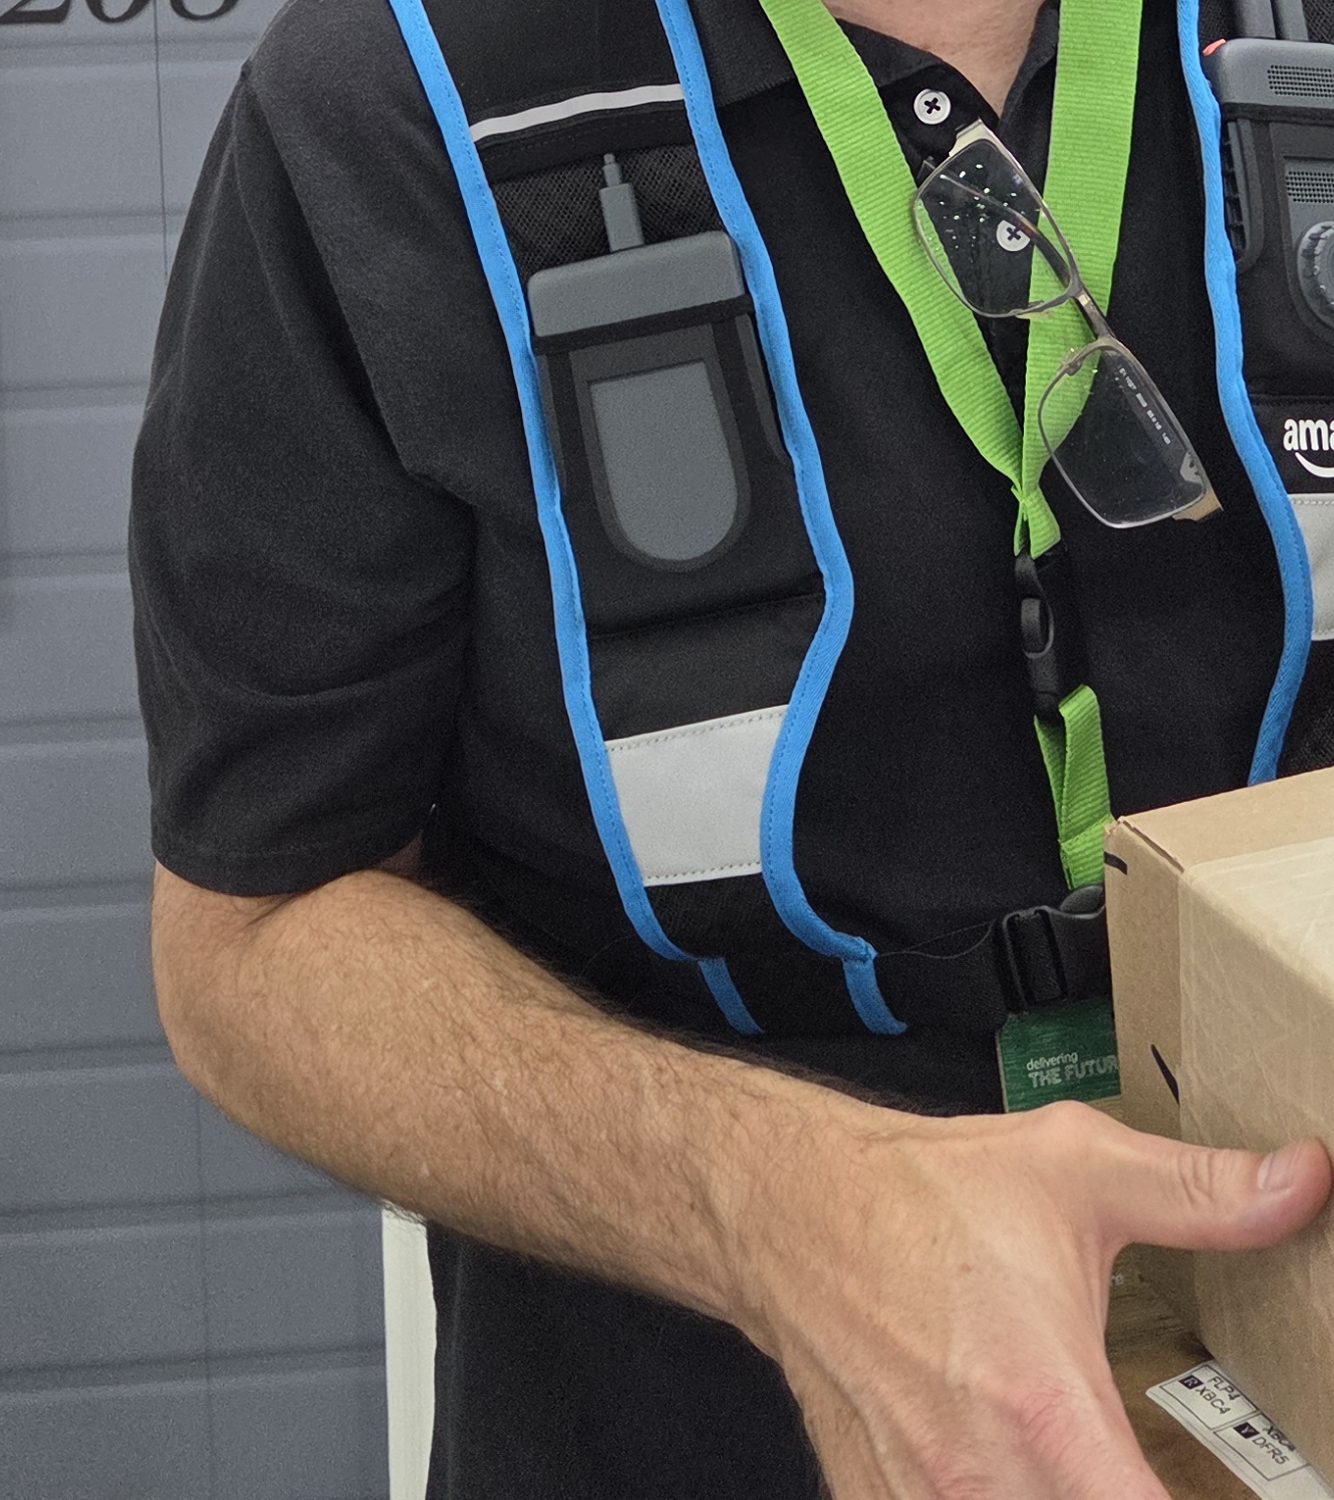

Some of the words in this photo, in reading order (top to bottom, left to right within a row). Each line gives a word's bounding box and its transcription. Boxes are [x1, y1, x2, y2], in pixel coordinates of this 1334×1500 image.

[1026, 1051, 1078, 1071] delivering
[1028, 1066, 1062, 1088] THE
[1064, 1055, 1118, 1081] FUTUR
[1196, 1386, 1231, 1415] XBC4
[1253, 1436, 1289, 1465] DFR5
